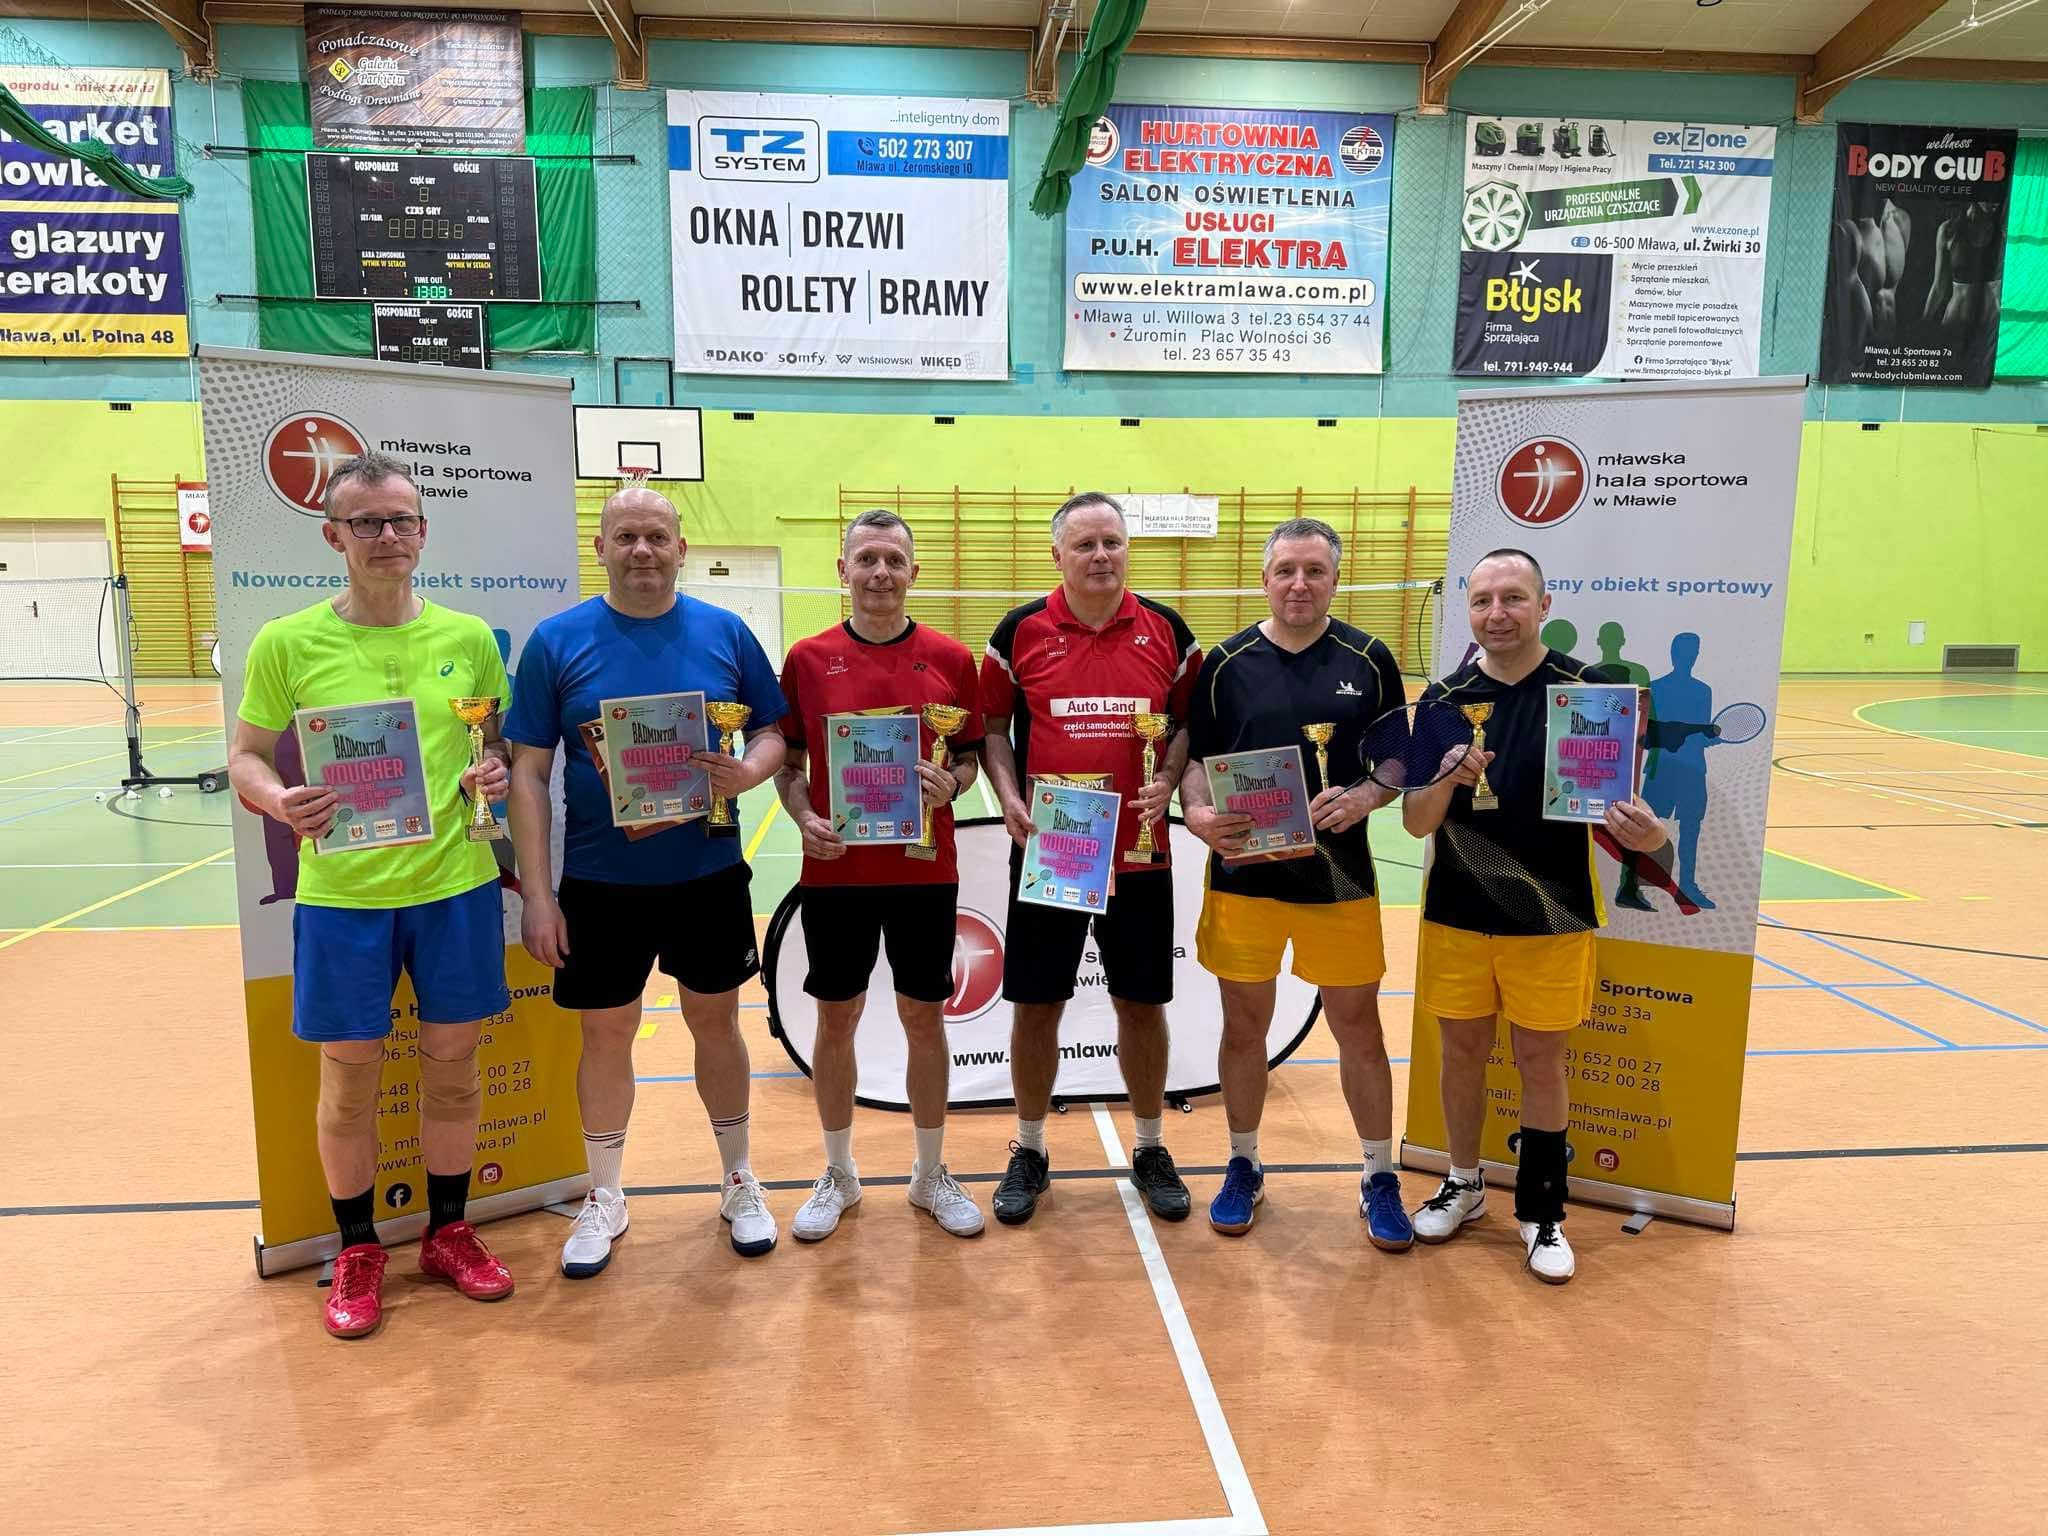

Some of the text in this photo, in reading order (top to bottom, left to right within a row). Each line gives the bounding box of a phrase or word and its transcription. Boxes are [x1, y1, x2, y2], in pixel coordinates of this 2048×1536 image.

[319, 31, 419, 57] Ponadczasowe
[9, 81, 59, 92] ogrodu
[320, 85, 422, 106] Podłogi Drewniane
[972, 112, 1000, 126] dom
[710, 127, 806, 155] TZ
[1141, 120, 1320, 150] HURTOWNIA
[1926, 133, 1973, 150] wellness
[878, 138, 974, 160] 502 273 307
[355, 160, 480, 173] GOSPODARZE GOŚCIE
[714, 156, 806, 171] SYSTEM
[962, 162, 973, 174] 10
[1123, 148, 1336, 179] ELEKTRYCZNA
[1471, 162, 1612, 174] Maszyny Chemia Mopy Higiena Pracy
[1679, 158, 1695, 169] 721
[1698, 159, 1715, 170] 542
[1718, 160, 1736, 171] 300
[1848, 144, 1928, 179] BODY
[1100, 182, 1355, 208] SALON OŚWIETLENIA
[1566, 188, 1641, 206] PROFESJONALNE
[1875, 182, 1972, 194] NEW QUALITY OF LIFE
[1544, 200, 1661, 222] URZĄDZENIA CZYSZCZĄCE
[690, 206, 904, 250] OKNA DRZWI
[1185, 211, 1275, 233] USŁUGI
[1692, 225, 1760, 236] www.exzone.pl
[10, 222, 165, 260] glazury
[1594, 236, 1760, 253] 06-500 Mława, ul. Żwirki 30
[1090, 237, 1348, 270] P.U.H. ELEKTRA
[415, 276, 443, 284] TIME OUT
[741, 273, 990, 317] ROLETY BRAMY
[1082, 279, 1367, 303] www.elektramlawa.com.pl
[1486, 278, 1582, 323] Błysk
[1628, 300, 1738, 311] Maszynowe mycie posadzek
[377, 307, 473, 319] GOSPODARZE GOŚCIE
[1084, 309, 1133, 324] Mława
[1143, 310, 1161, 324] ul.
[1167, 310, 1225, 325] Willowa
[1231, 312, 1240, 325] 3
[1297, 313, 1325, 326] 654
[1330, 314, 1348, 327] 37
[1353, 315, 1370, 327] 44
[1628, 313, 1652, 321] Pranie
[1654, 313, 1676, 321] mebli
[1123, 325, 1332, 345] Żuromin Plac Wolności 36
[1485, 322, 1512, 331] Firma
[63, 329, 174, 344] ul. Polna 48
[412, 337, 449, 346] CZAS GRY
[1484, 332, 1539, 345] Sprzątająca
[1668, 339, 1723, 348] poremontowe
[716, 349, 765, 363] DAKO
[858, 354, 913, 365] WIŚNIOWSKI
[1164, 347, 1291, 362] tel. 23 657 35 43
[1904, 347, 1941, 357] Sportowa
[1484, 361, 1573, 373] tel. 791-949-944
[1877, 358, 1889, 366] tel.
[1902, 359, 1916, 367] 655
[1918, 359, 1928, 367] 20
[1929, 359, 1940, 367] 82
[1851, 370, 1963, 381] www.bodyclubmlawa.com
[380, 437, 471, 455] mławska
[1597, 452, 1686, 467] mławska
[442, 464, 532, 482] sportowa
[1596, 472, 1748, 490] hala sportowa
[1594, 494, 1677, 507] w Mławie
[470, 573, 568, 593] sportowy
[1590, 576, 1660, 593] obiekt
[1666, 578, 1773, 598] sportowy
[1067, 700, 1136, 713] Auto Land
[632, 721, 677, 744] BADMINTON
[1063, 721, 1085, 732] części
[1570, 711, 1610, 737] BADMINTON
[332, 734, 388, 760] BADMINTON
[854, 741, 894, 763] BADMINTON
[1558, 740, 1619, 761] VOUCHER
[324, 759, 405, 786] VOUCHER
[843, 767, 905, 786] VOUCHER
[1233, 772, 1277, 792] BADMINTON
[1053, 809, 1091, 834] BADMINTON
[1040, 832, 1100, 857] VOUCHER
[1600, 979, 1694, 1004] Sportowa
[1621, 1005, 1652, 1021] 33a
[1583, 1051, 1612, 1066] 652
[1617, 1057, 1637, 1071] 00
[1642, 1062, 1662, 1075] 27
[379, 1060, 531, 1099] +48 00 27
[1581, 1068, 1610, 1084] 652
[1615, 1074, 1635, 1088] 00
[1641, 1078, 1660, 1092] 28
[377, 1078, 532, 1117] +48 00 28
